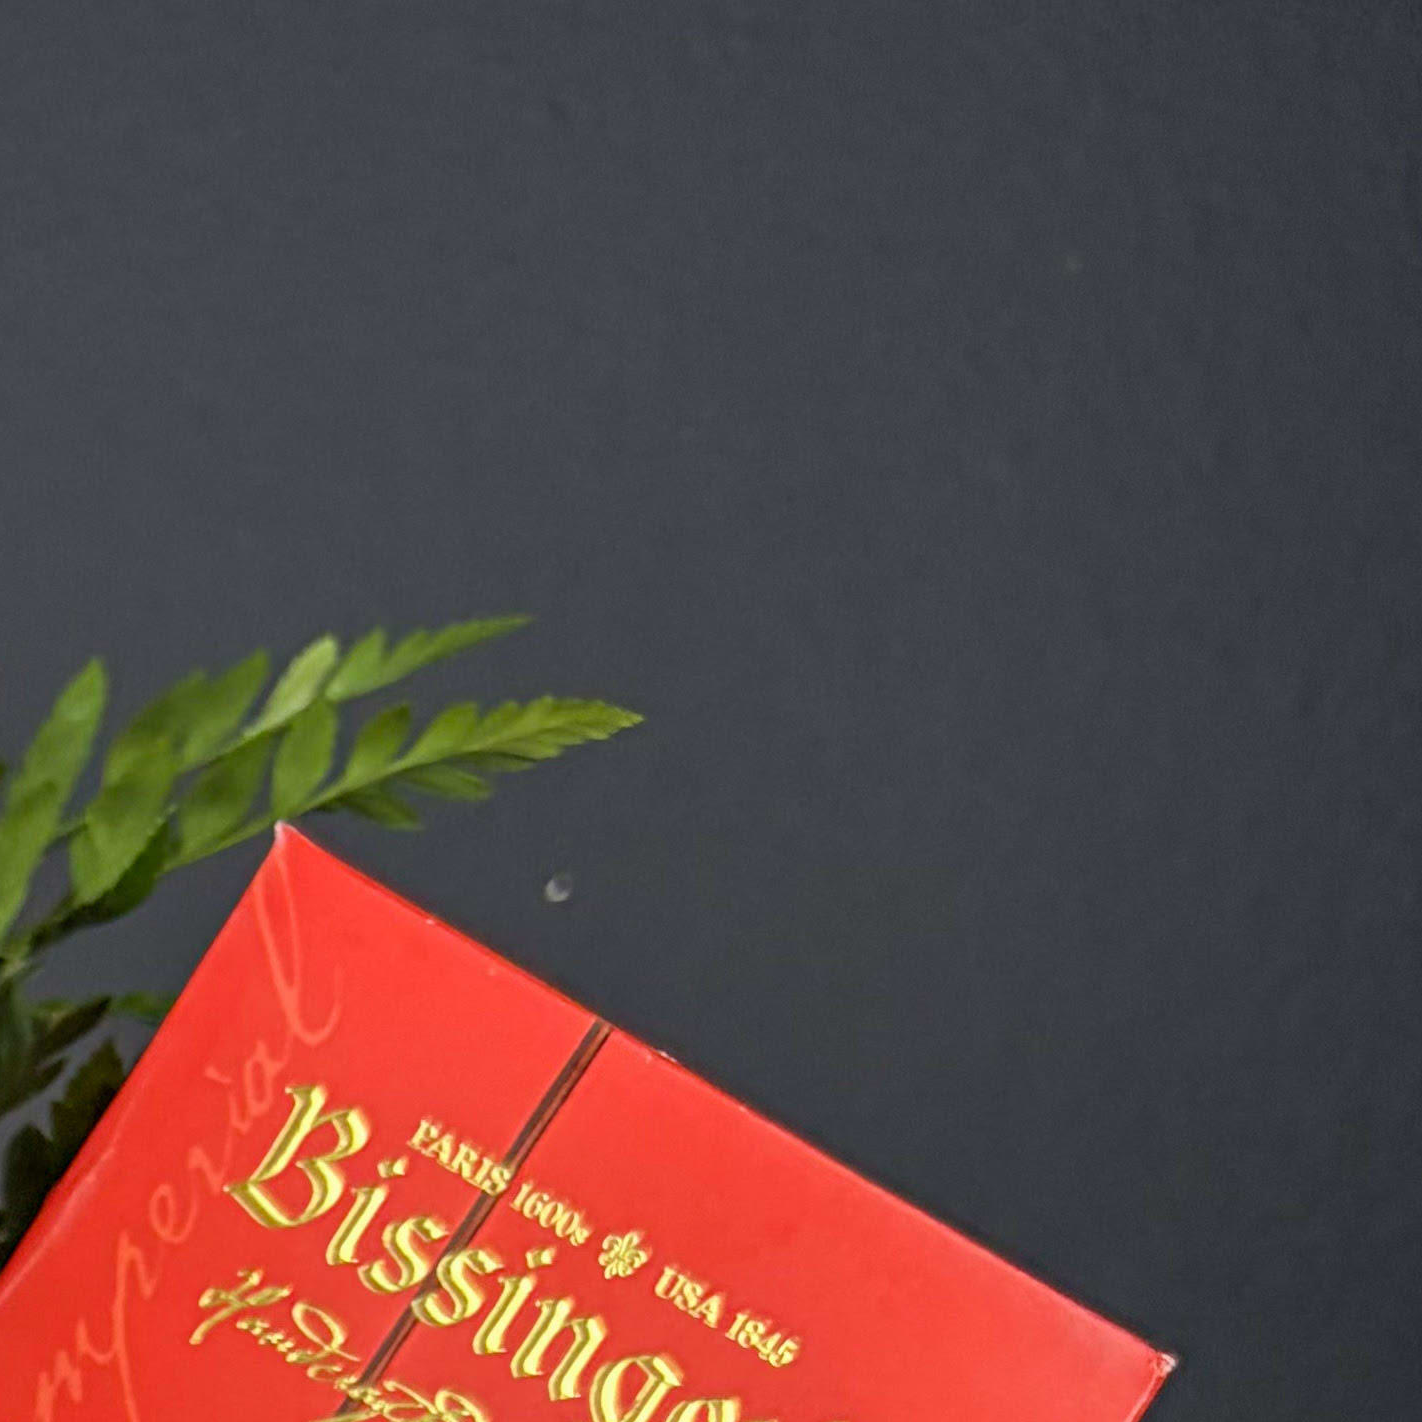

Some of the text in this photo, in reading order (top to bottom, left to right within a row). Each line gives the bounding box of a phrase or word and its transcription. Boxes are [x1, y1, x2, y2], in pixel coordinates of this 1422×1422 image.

[406, 1117, 802, 1368] PARIS 1600s USA 1845
